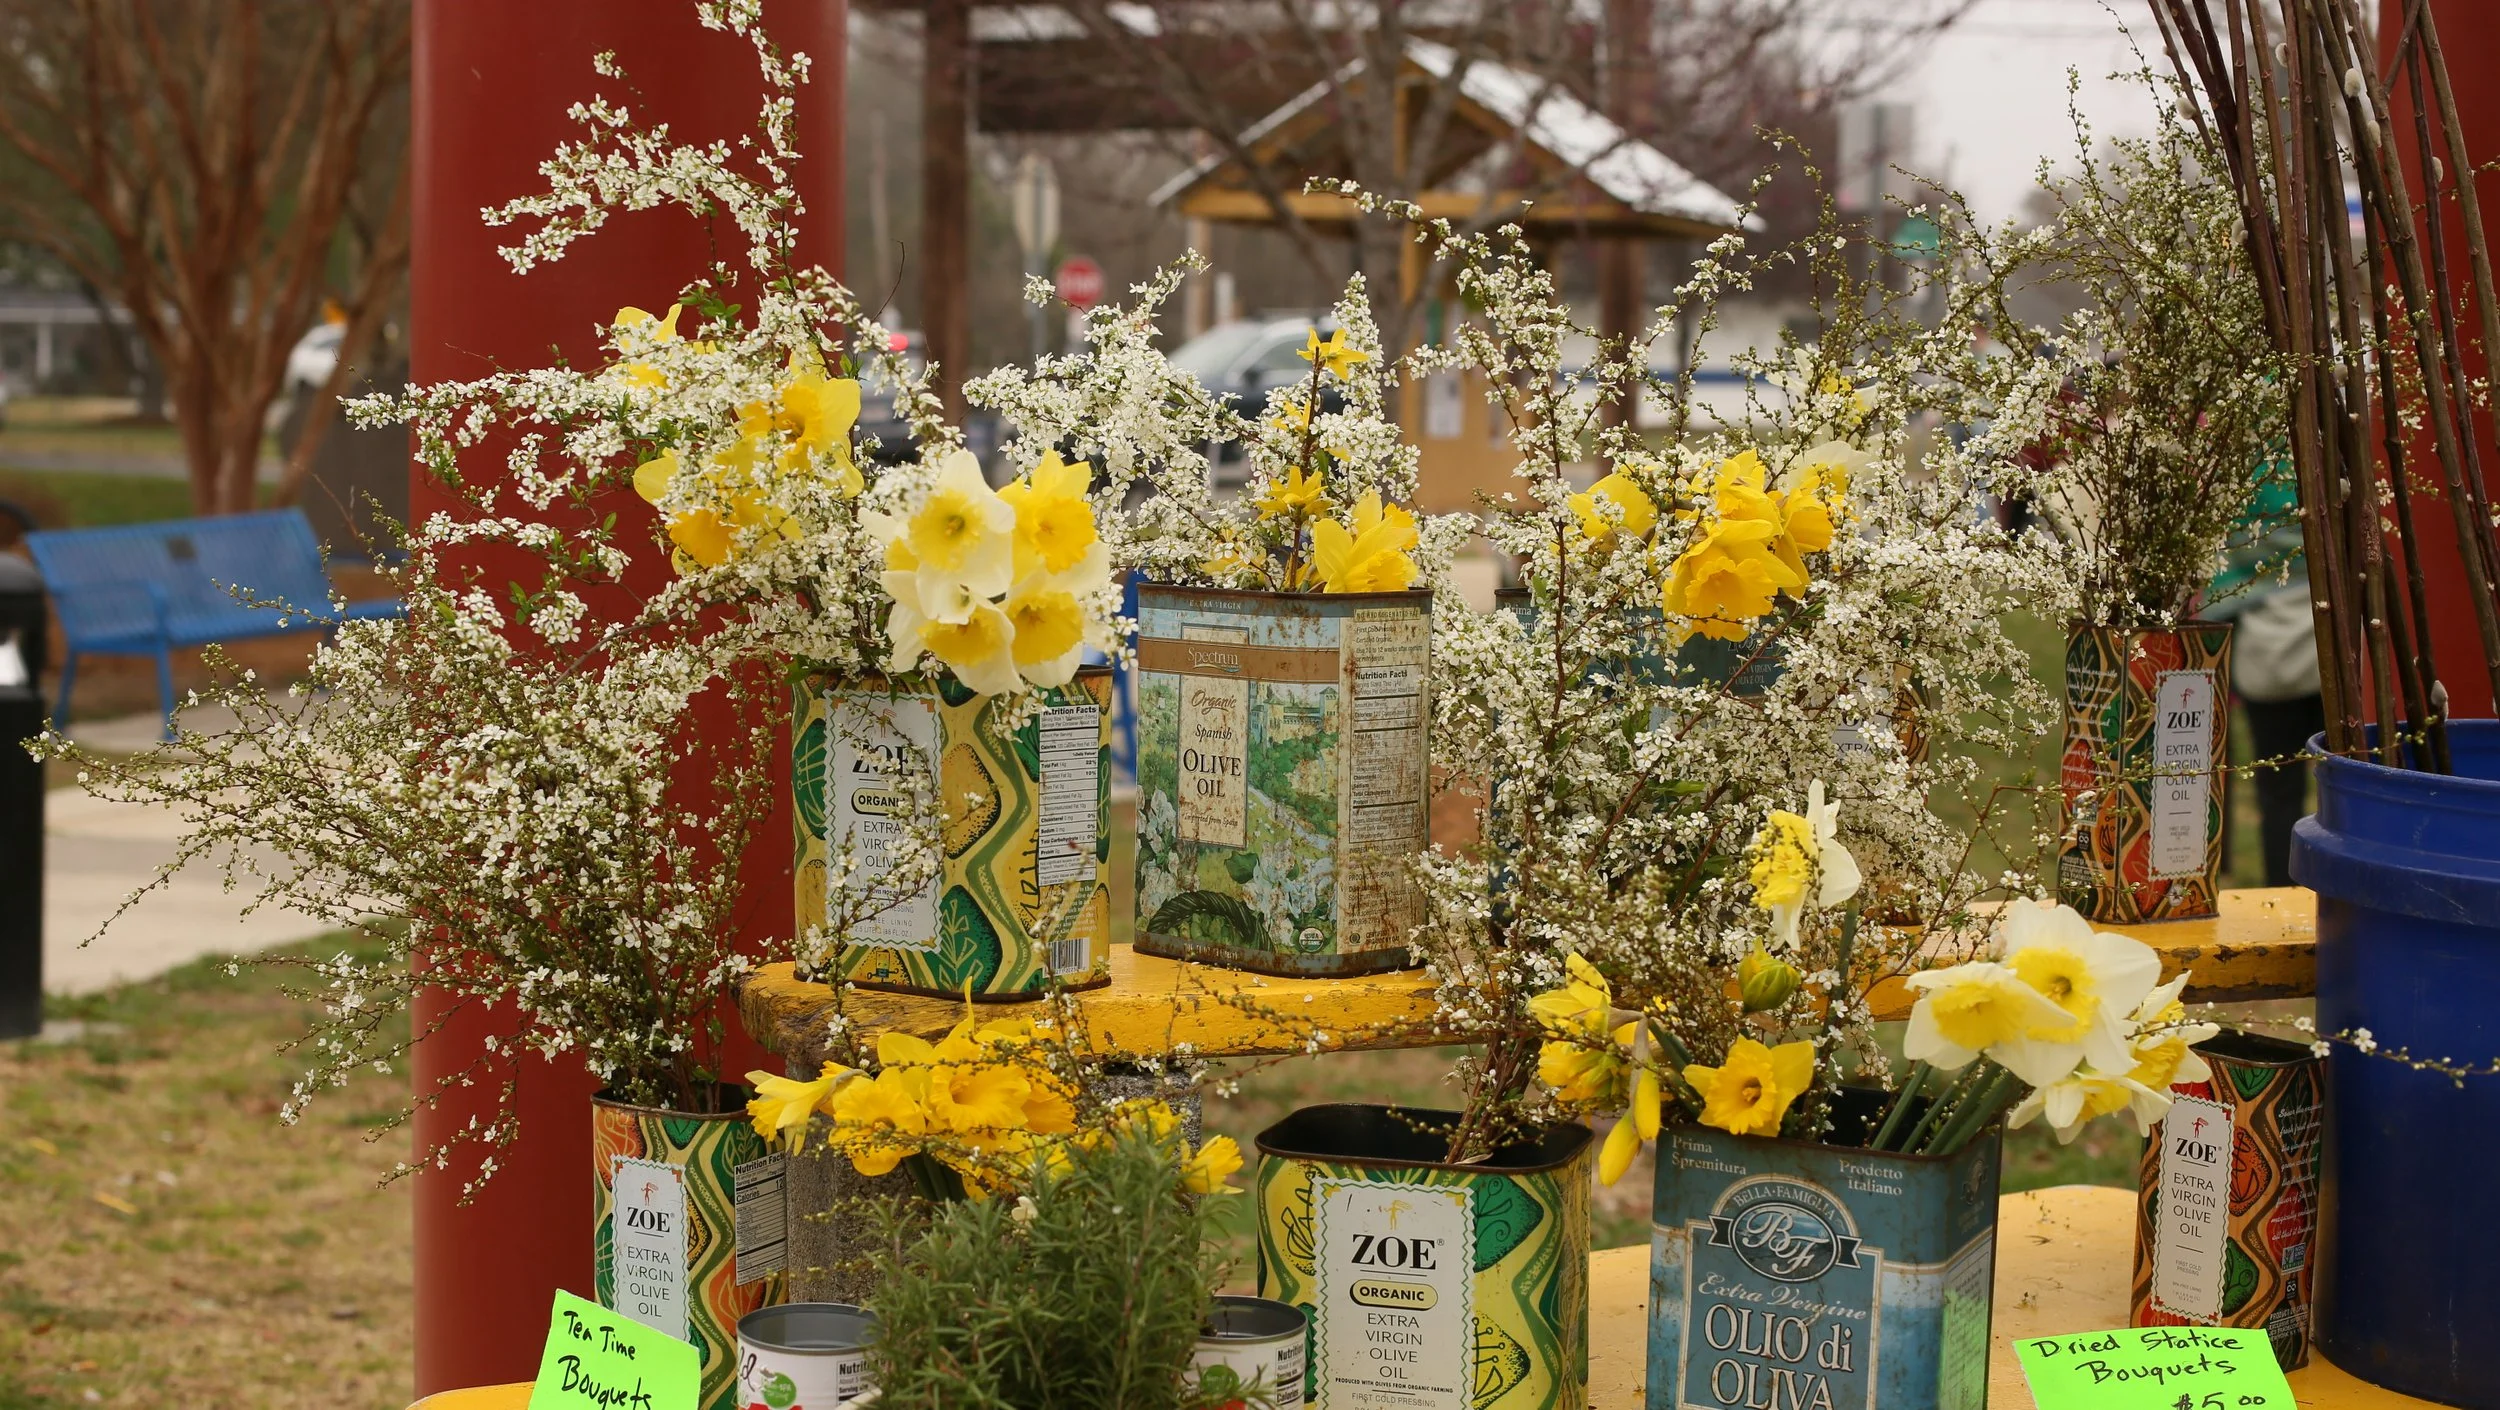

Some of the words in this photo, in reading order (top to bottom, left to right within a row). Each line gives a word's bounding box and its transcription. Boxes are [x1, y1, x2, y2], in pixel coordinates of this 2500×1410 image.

[1188, 647, 1238, 666] Spectrum
[1356, 671, 1387, 680] Nutrition
[1389, 670, 1407, 678] Facts
[1076, 706, 1096, 714] Facts
[1191, 690, 1237, 715] Organic
[2167, 711, 2202, 729] ZOE
[1195, 723, 1232, 742] Spanish
[2166, 744, 2200, 756] EXTRA
[1183, 748, 1241, 777] OLIVE
[2164, 759, 2200, 770] VIRGIN
[1197, 778, 1225, 798] OIL
[2166, 775, 2197, 786] OLIVE
[858, 794, 905, 808] ORGAN
[2171, 790, 2190, 801] OIL
[864, 821, 902, 834] EXTRA
[1672, 1135, 1713, 1154] Prima
[2175, 1137, 2217, 1164] ZOE
[736, 1159, 767, 1175] Nutrition
[1671, 1152, 1747, 1176] Spremitura
[1839, 1159, 1904, 1181] Prodotto
[1848, 1179, 1902, 1196] Italiano
[2174, 1172, 2215, 1192] EXTRA
[737, 1190, 760, 1203] Calories
[2171, 1187, 2216, 1209] VIRGIN
[627, 1206, 670, 1233] ZOE
[2173, 1204, 2212, 1224] OLIVE
[2179, 1222, 2202, 1238] OIL
[1742, 1209, 1830, 1275] BF
[627, 1246, 671, 1265] EXTRA
[626, 1263, 674, 1283] VIRGIN
[630, 1282, 670, 1301] OLIVE
[1359, 1286, 1425, 1302] ORGANIC
[1698, 1271, 1764, 1303] Extra
[1766, 1285, 1867, 1328] Vergine
[638, 1302, 662, 1318] OIL
[1367, 1312, 1420, 1328] EXTRA
[563, 1310, 593, 1342] Tea
[599, 1326, 636, 1361] Time
[1365, 1329, 1423, 1346] VIRGIN
[1704, 1302, 1811, 1364] OLIO
[1817, 1323, 1854, 1373] di
[2031, 1334, 2121, 1358] Dried
[2140, 1329, 2244, 1351] Statice
[1369, 1347, 1418, 1363] OLIVE
[1379, 1365, 1409, 1379] OIL
[2075, 1353, 2237, 1385] Bouquets
[557, 1355, 653, 1410] Bouquets
[839, 1386, 858, 1394] Serving
[1335, 1377, 1360, 1385] PRODUCED
[1408, 1384, 1430, 1392] ORGANIC
[1711, 1358, 1835, 1410] OLIVA
[1276, 1389, 1299, 1403] Calories
[1351, 1392, 1373, 1401] FIRST
[1375, 1395, 1396, 1403] COLD
[1397, 1397, 1436, 1408] PRESSING
